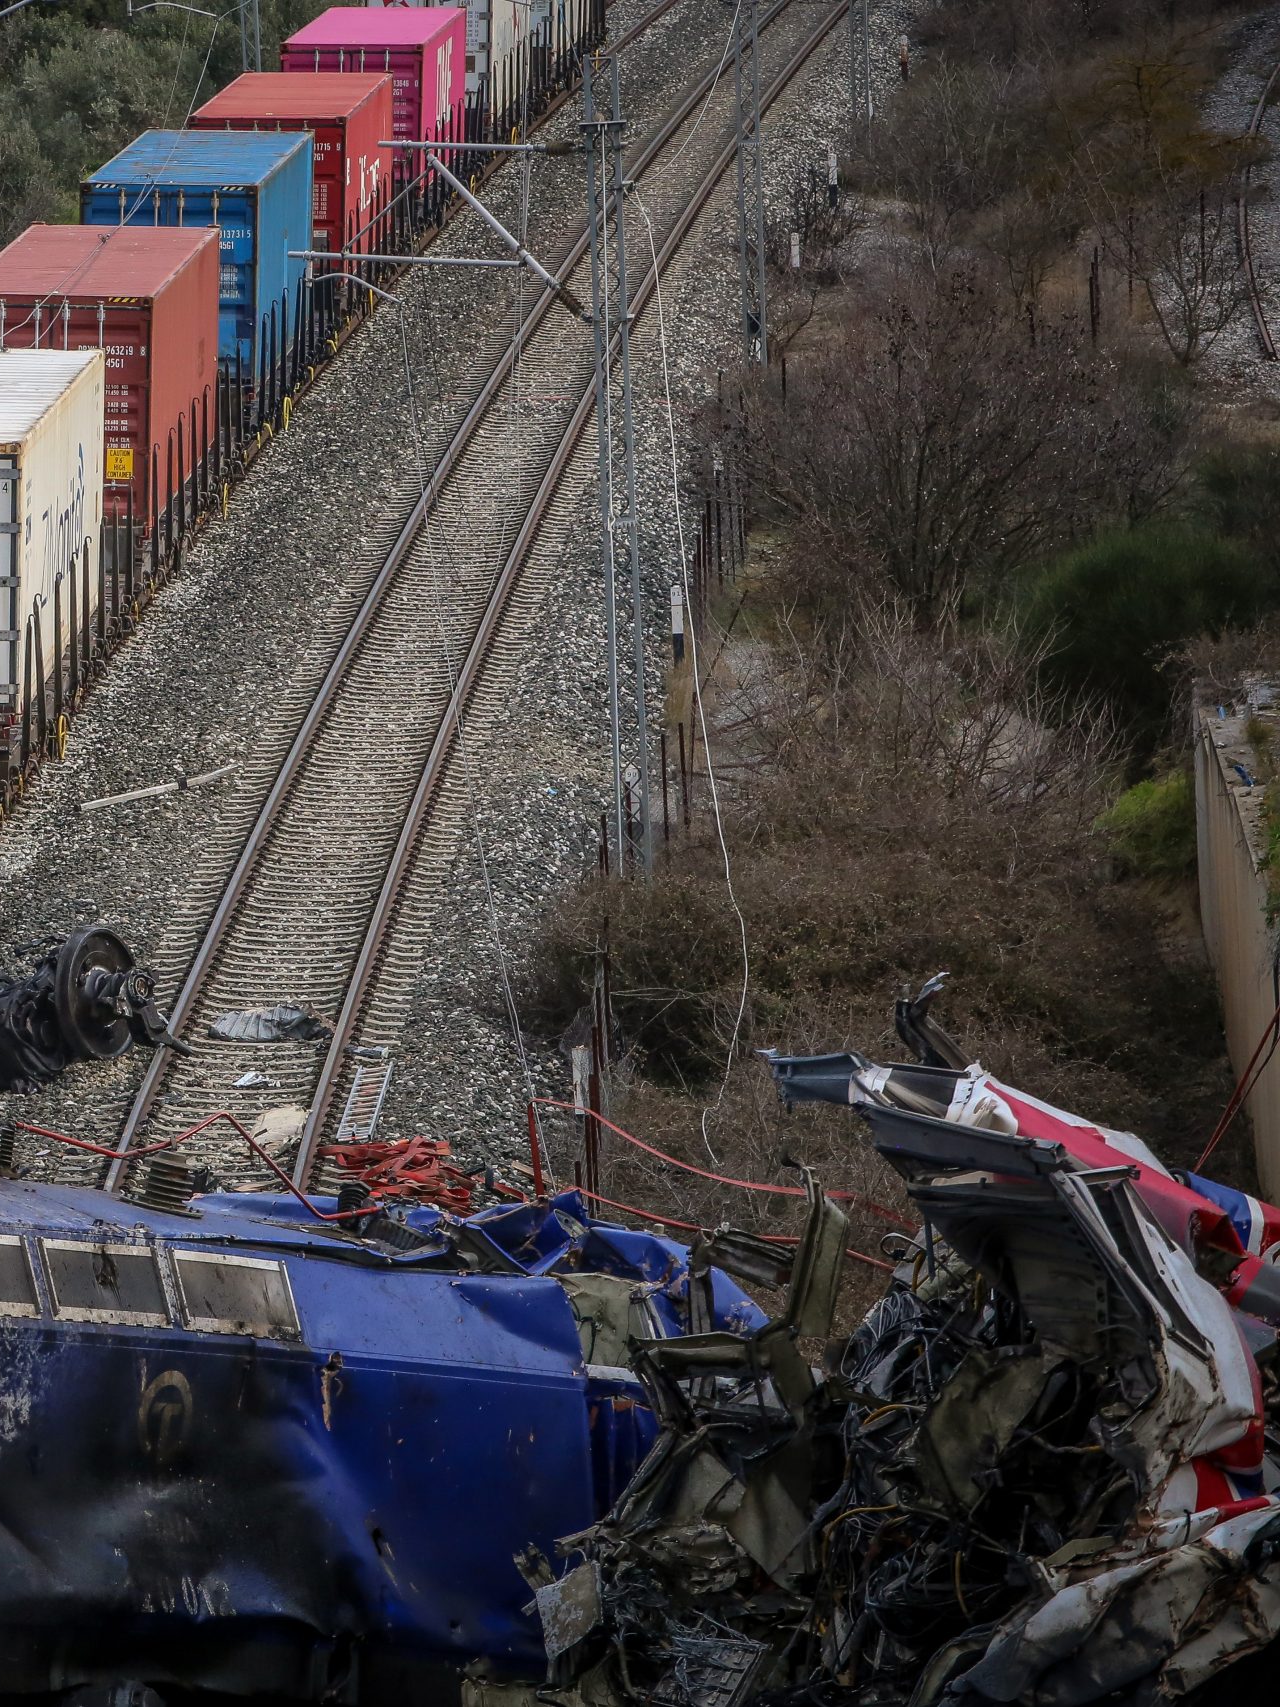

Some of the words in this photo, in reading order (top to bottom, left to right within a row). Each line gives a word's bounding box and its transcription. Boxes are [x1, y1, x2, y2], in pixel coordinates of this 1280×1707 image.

[246, 230, 251, 238] 5
[141, 346, 146, 356] 8
[105, 359, 124, 368] 45G1
[2, 482, 8, 493] 4
